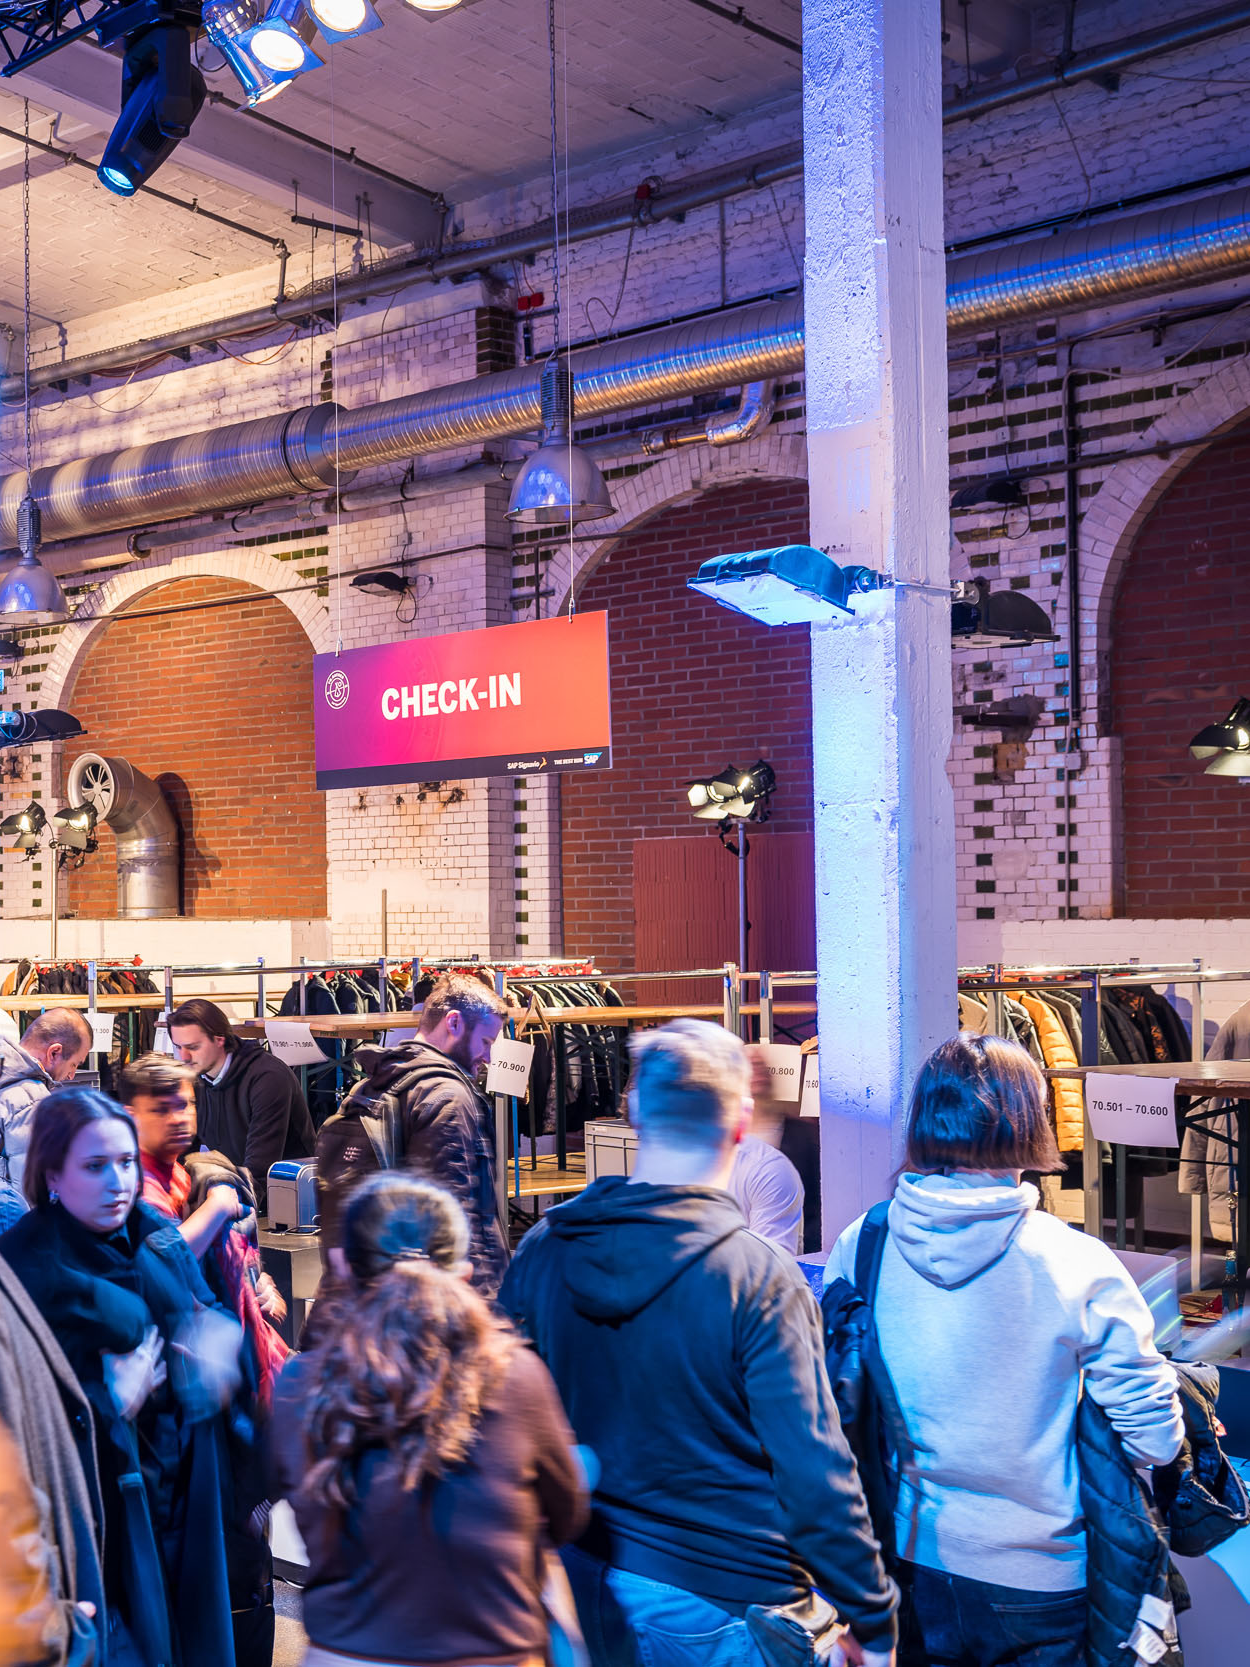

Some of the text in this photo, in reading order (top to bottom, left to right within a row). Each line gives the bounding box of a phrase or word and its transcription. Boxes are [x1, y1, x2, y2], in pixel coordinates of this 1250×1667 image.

[381, 672, 522, 721] CHECK-IN
[518, 760, 540, 769] Signavio
[584, 754, 599, 765] SAP
[497, 1060, 526, 1073] 70.900
[805, 1079, 819, 1089] 70.60
[1092, 1100, 1123, 1112] 70.501
[1135, 1104, 1168, 1116] 70.600
